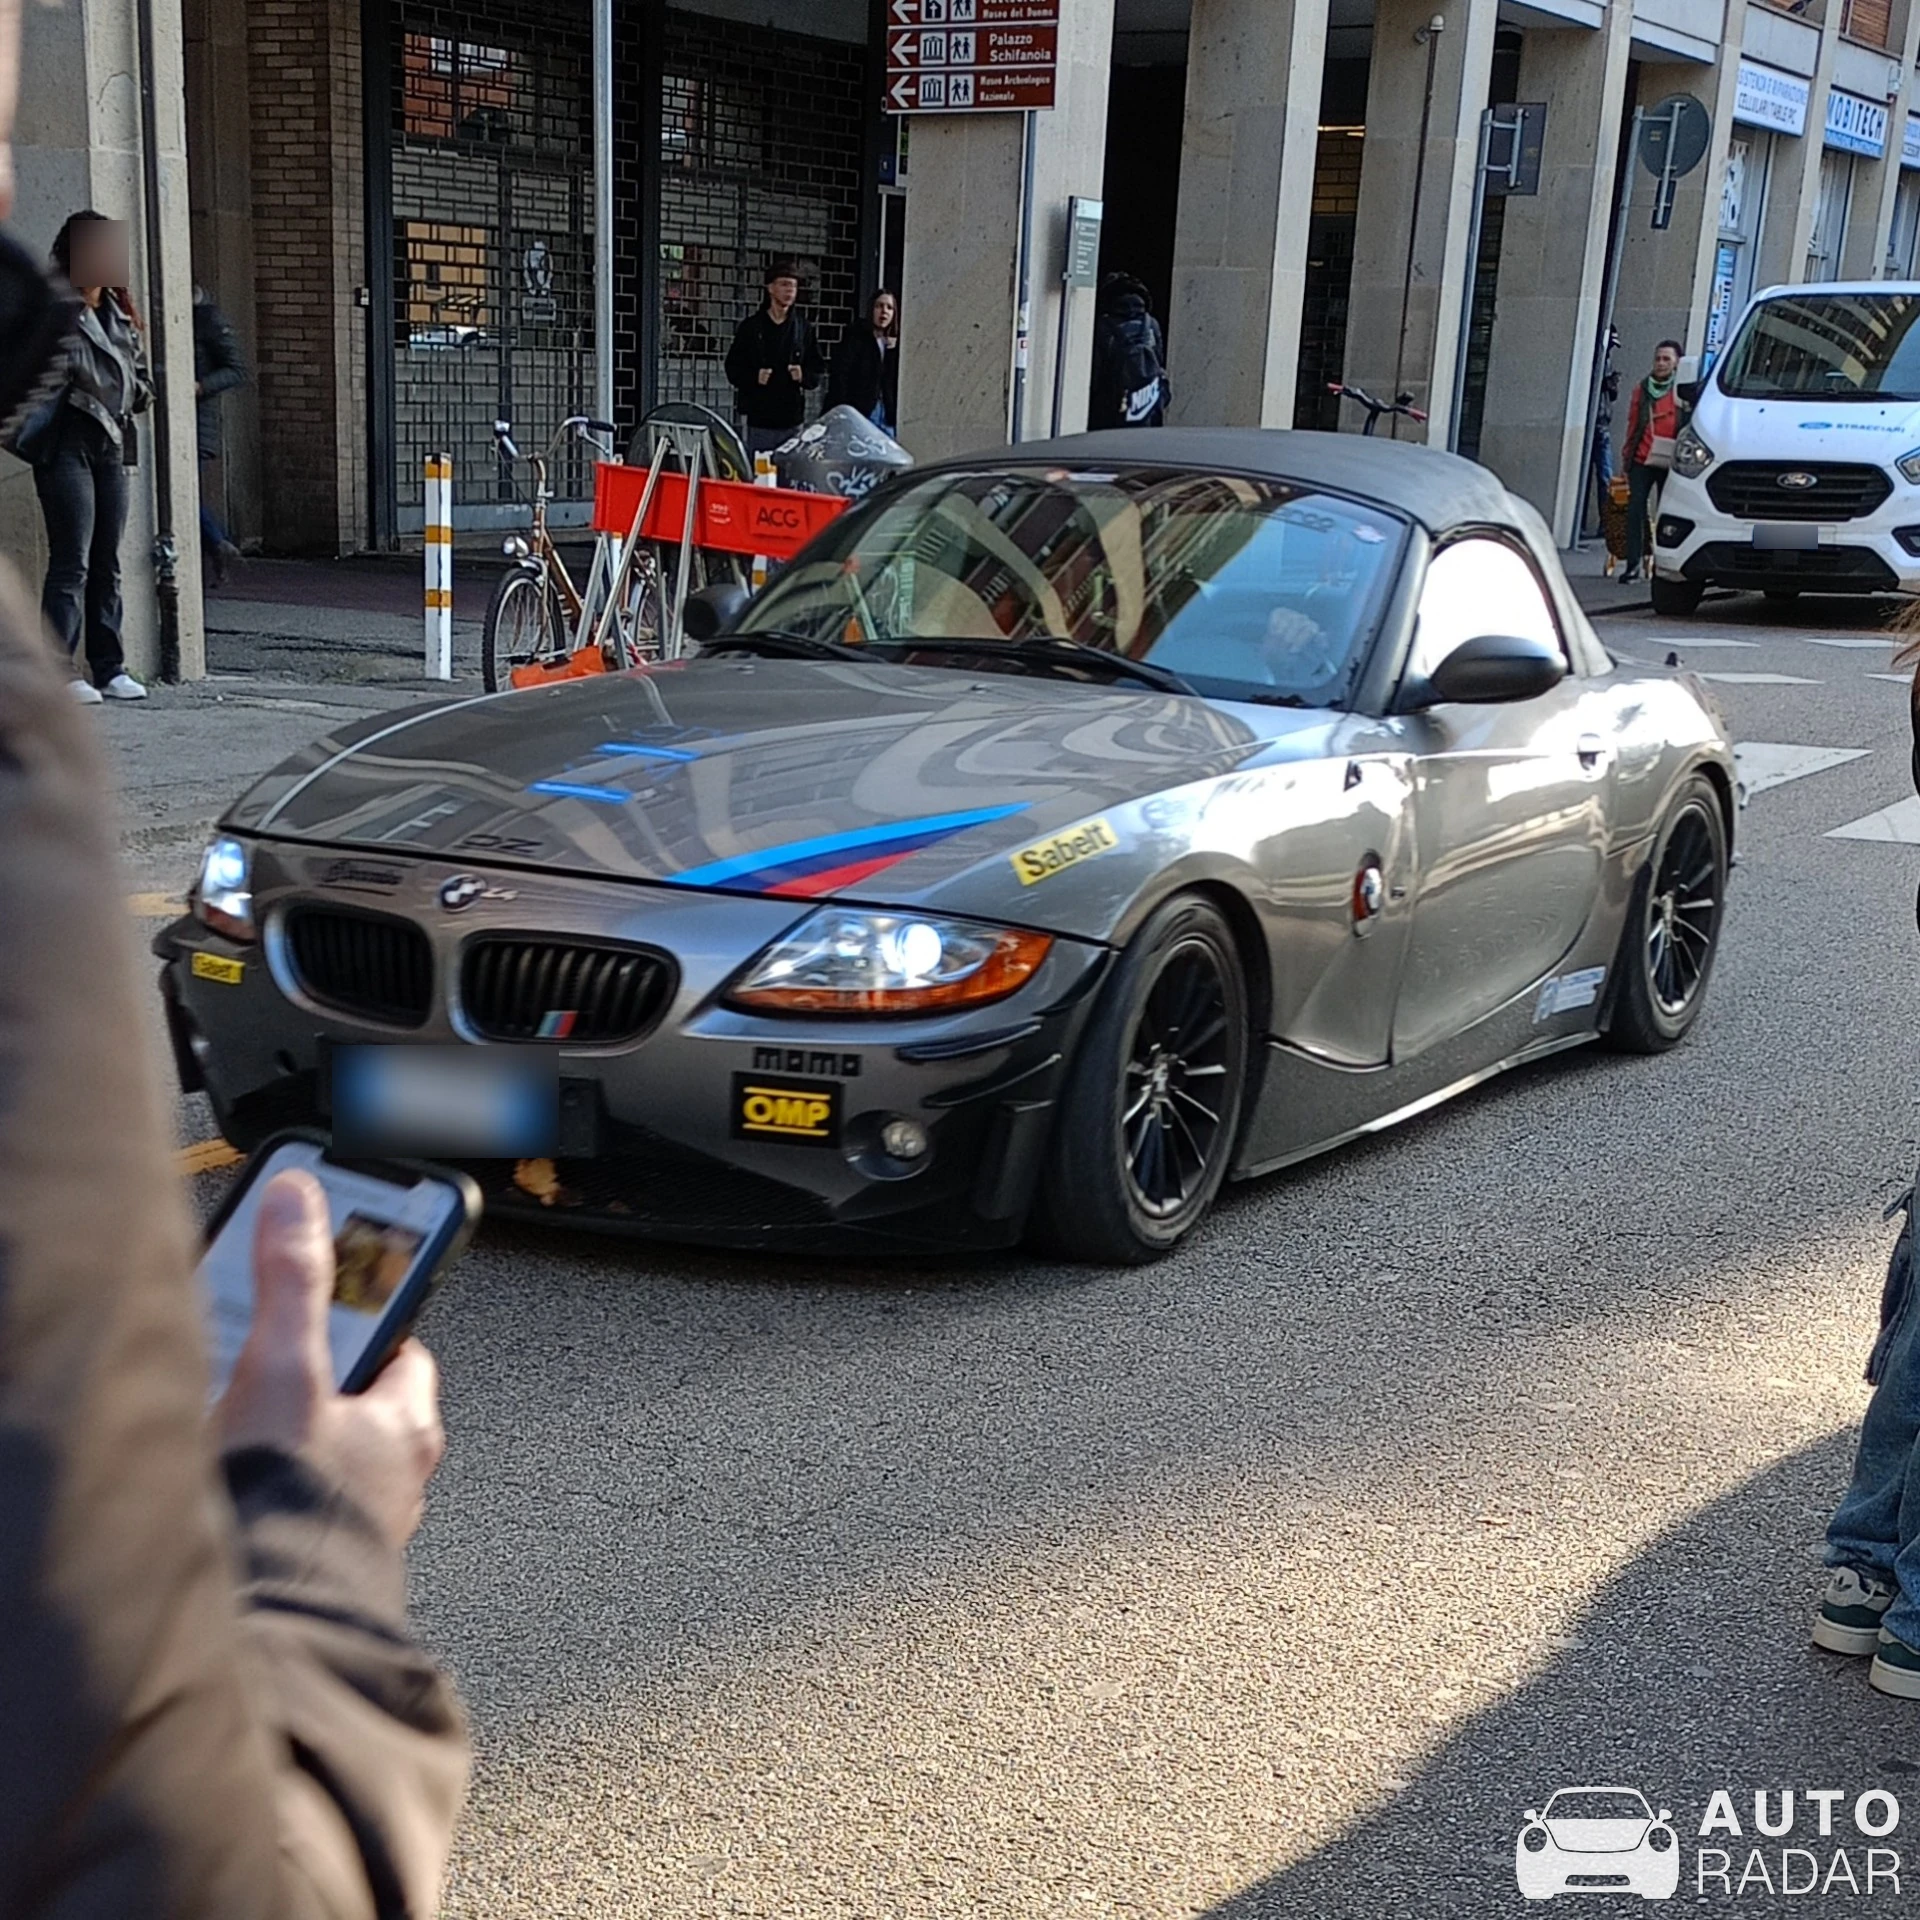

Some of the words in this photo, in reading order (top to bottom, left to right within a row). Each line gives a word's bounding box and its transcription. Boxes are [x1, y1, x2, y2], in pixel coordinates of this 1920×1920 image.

[989, 32, 1034, 46] Palazzo
[989, 47, 1052, 63] Schifanoia
[755, 505, 801, 529] ACG
[1019, 824, 1113, 878] Sabelt
[752, 1046, 863, 1077] momo
[742, 1094, 832, 1128] OMP
